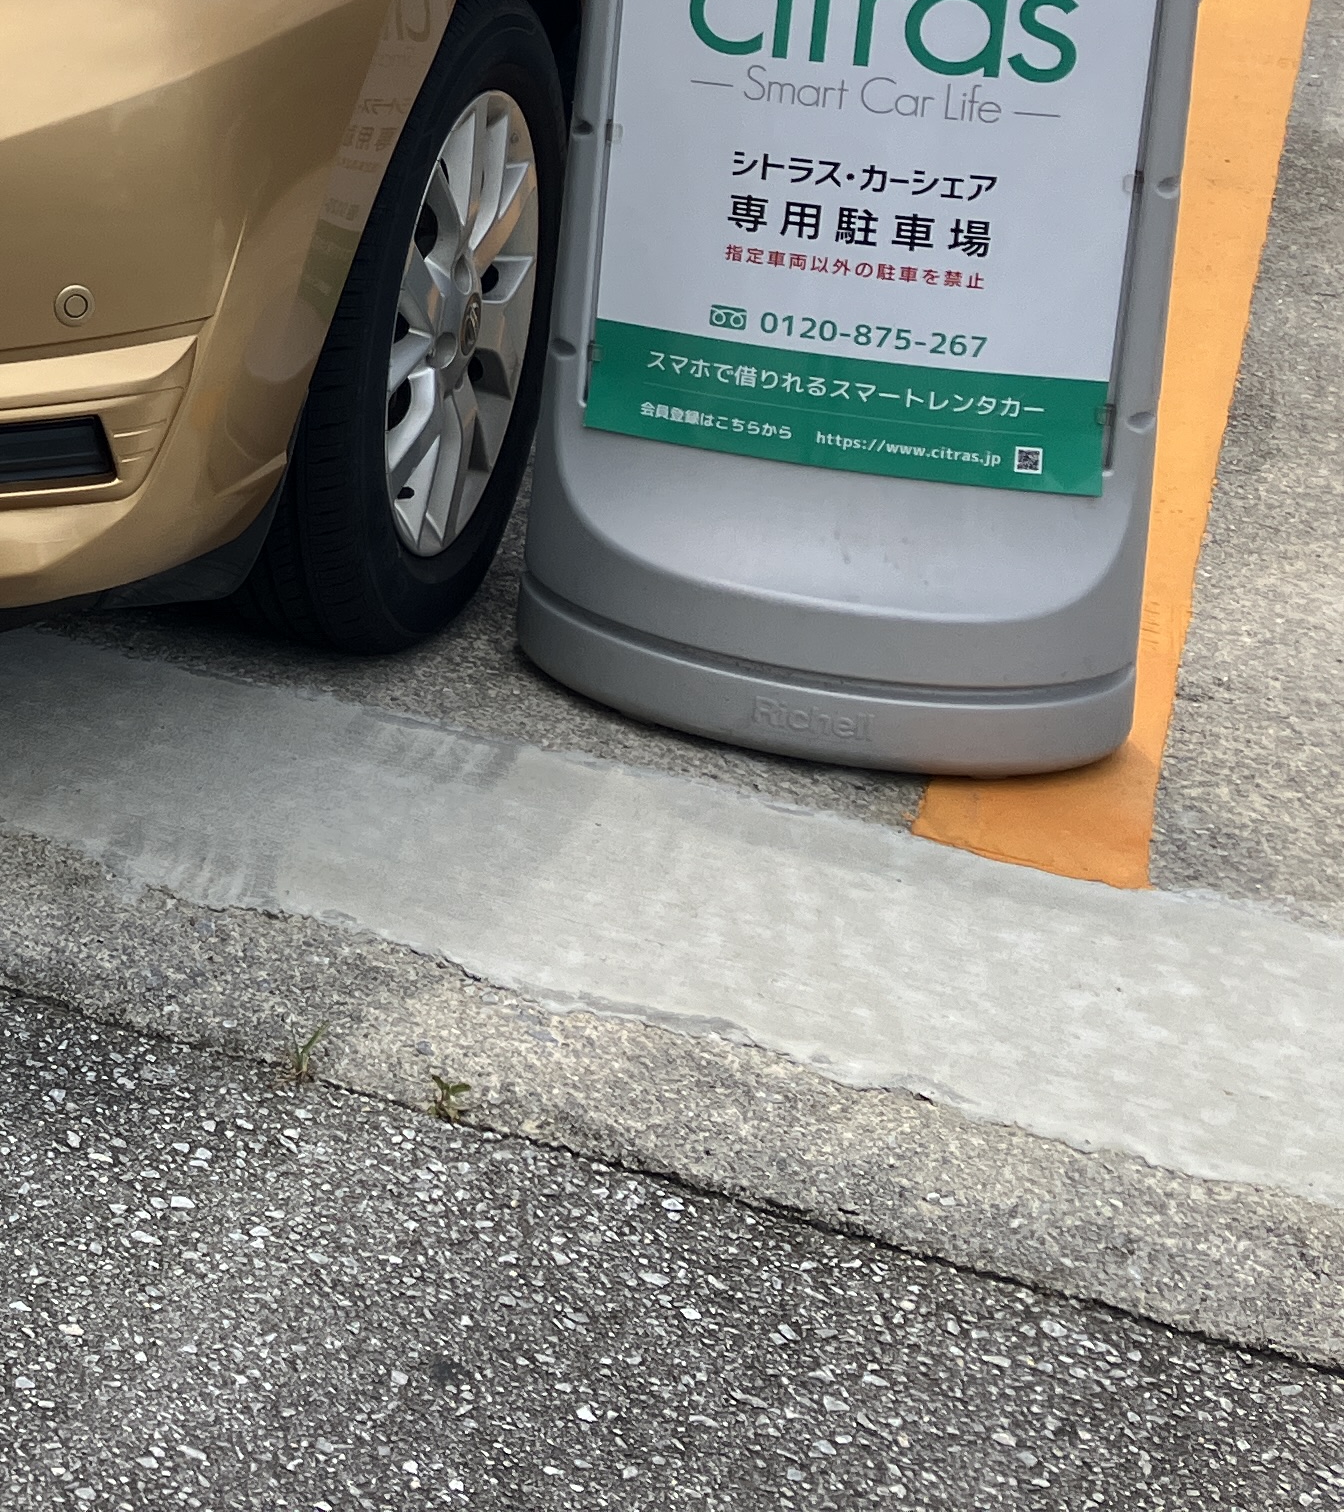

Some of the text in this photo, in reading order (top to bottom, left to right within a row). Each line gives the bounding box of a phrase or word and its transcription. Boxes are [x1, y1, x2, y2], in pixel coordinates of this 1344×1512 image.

[743, 65, 1002, 124] Smart Car Life
[731, 150, 998, 202] シトラス・カーシェア
[727, 194, 992, 258] 専用駐車場
[725, 244, 986, 290] 指定車両以外の駐車を禁止
[760, 311, 988, 359] 0120-875-267
[646, 351, 1045, 417] スマホで借りれるスマートレンタカー
[640, 401, 1002, 468] 会員登録はこちらから https://www.citras.jp
